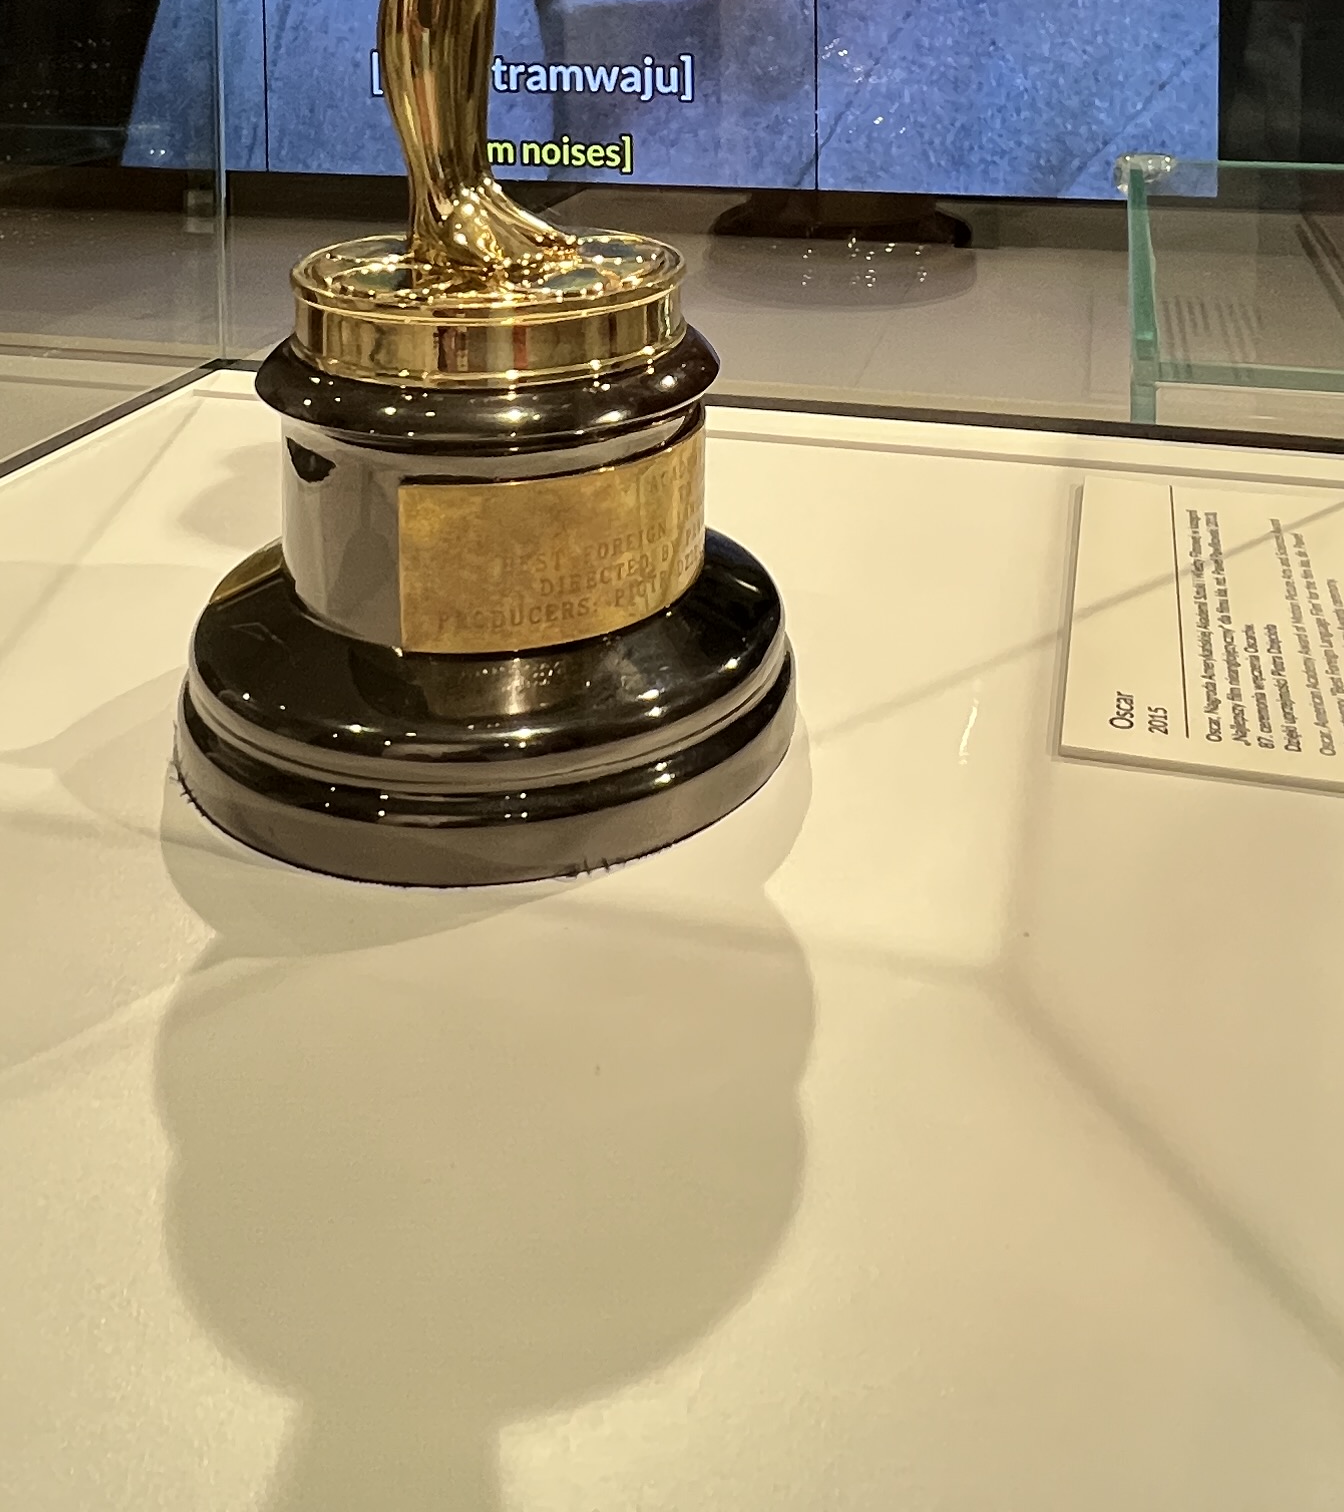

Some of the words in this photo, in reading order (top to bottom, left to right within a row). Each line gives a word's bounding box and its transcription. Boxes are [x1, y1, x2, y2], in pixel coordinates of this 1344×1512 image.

[491, 54, 693, 102] tramwaju]
[522, 135, 633, 174] noises]
[1109, 691, 1134, 729] Oscar
[1148, 706, 1168, 735] 2015
